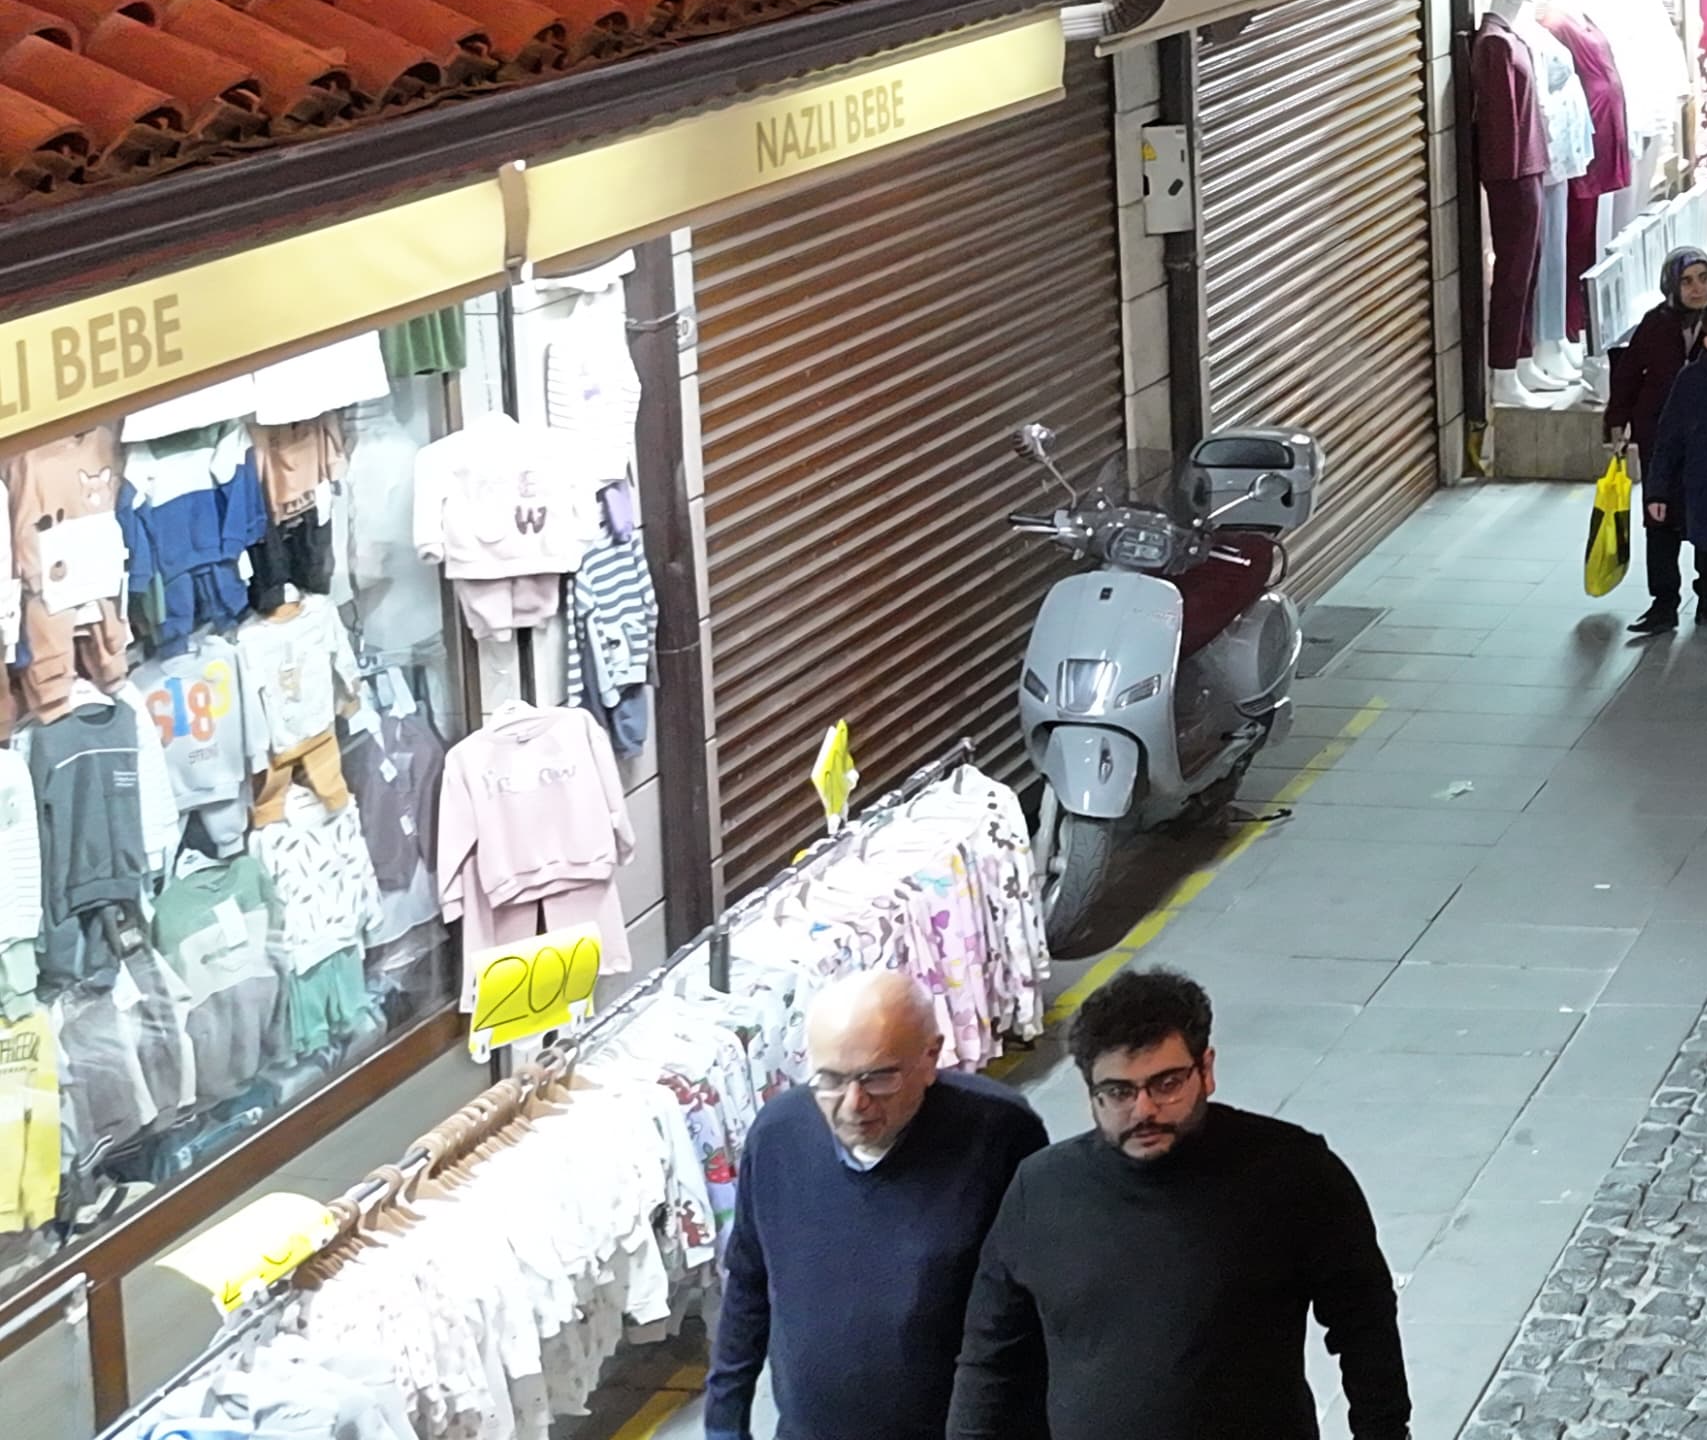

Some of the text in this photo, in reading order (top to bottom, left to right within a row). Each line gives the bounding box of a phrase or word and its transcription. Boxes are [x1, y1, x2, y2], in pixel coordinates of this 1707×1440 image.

[755, 80, 905, 173] NAZLI BEBE
[51, 294, 183, 401] BEBE
[474, 937, 600, 1032] 200
